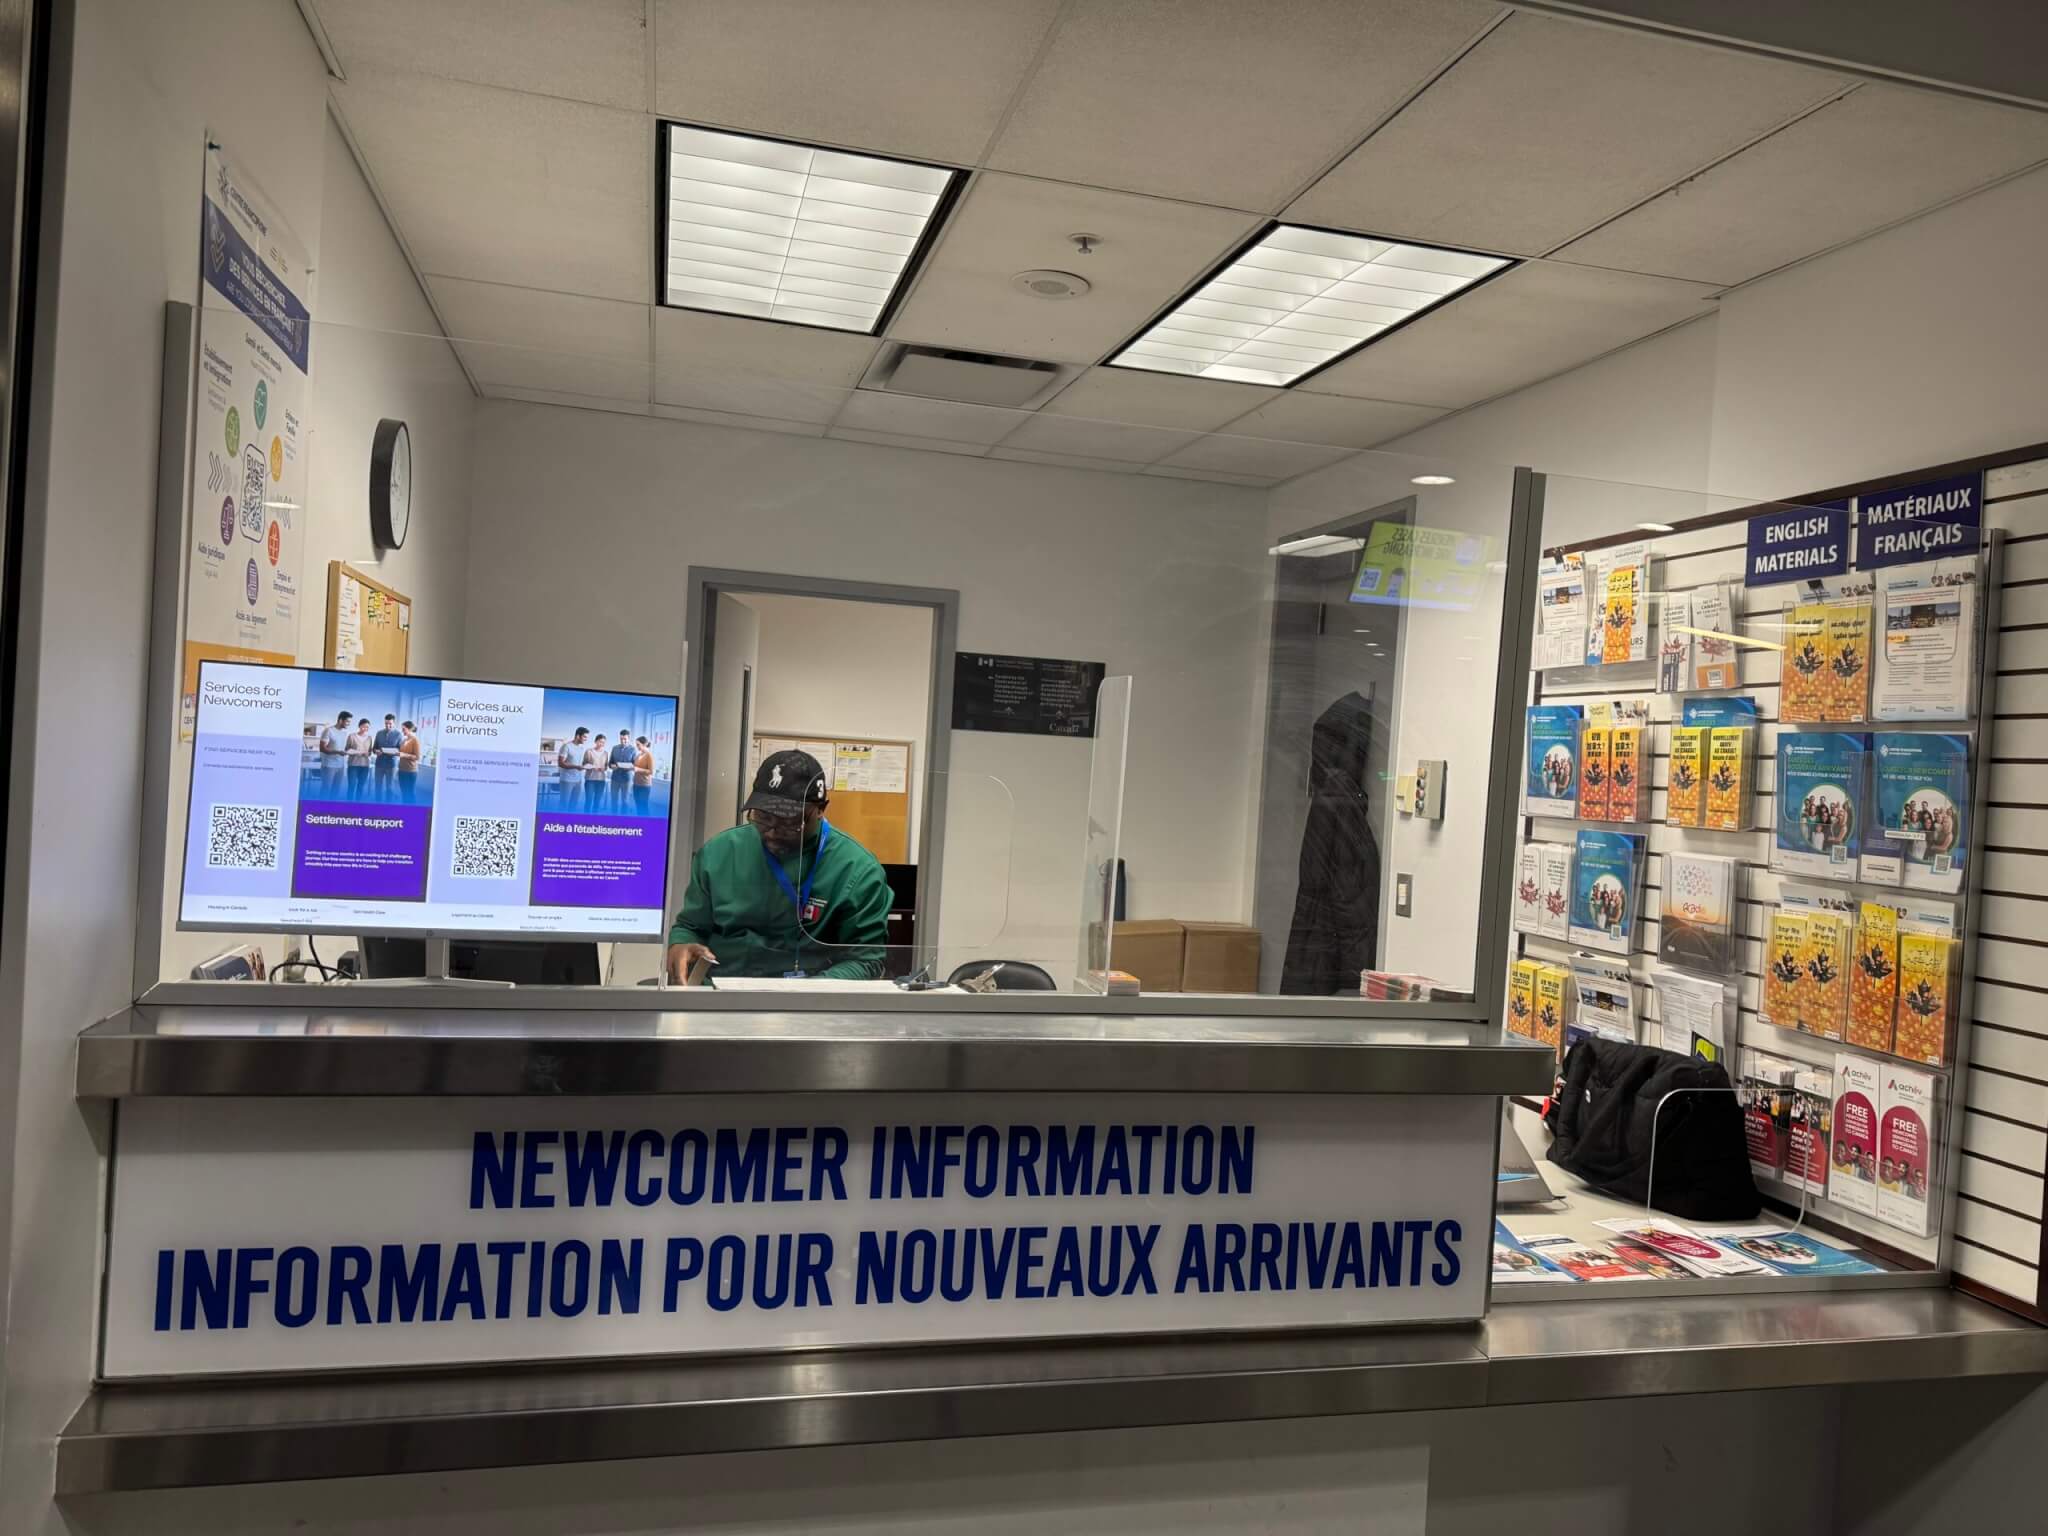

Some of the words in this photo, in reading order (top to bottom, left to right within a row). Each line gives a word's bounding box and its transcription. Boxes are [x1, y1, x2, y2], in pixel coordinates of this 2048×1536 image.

[1867, 488, 1972, 525] MATÉRIAUX
[1766, 516, 1829, 544] ENGLISH
[1874, 523, 1963, 553] FRANÇAIS
[1755, 545, 1838, 574] MATERIALS
[205, 681, 261, 695] Services
[263, 685, 282, 697] for
[203, 694, 283, 710] Newcomers
[448, 698, 500, 712] Services
[501, 705, 524, 714] aux
[446, 712, 505, 725] nouveaux
[446, 725, 498, 737] arrivants
[816, 779, 825, 799] 3
[305, 814, 362, 827] Settlement
[364, 818, 404, 829] support
[543, 823, 565, 834] Aide
[566, 824, 573, 834] à
[573, 824, 643, 837] l'établissement
[1846, 1103, 1868, 1119] FREE
[1893, 1117, 1918, 1135] FREE
[470, 1131, 848, 1209] NEWCOMER
[871, 1126, 1255, 1199] INFORMATION
[154, 1238, 643, 1332] INFORMATION
[663, 1232, 834, 1313] POUR
[855, 1224, 1160, 1305] NOUVEAUX
[1175, 1220, 1462, 1293] ARRIVANTS
